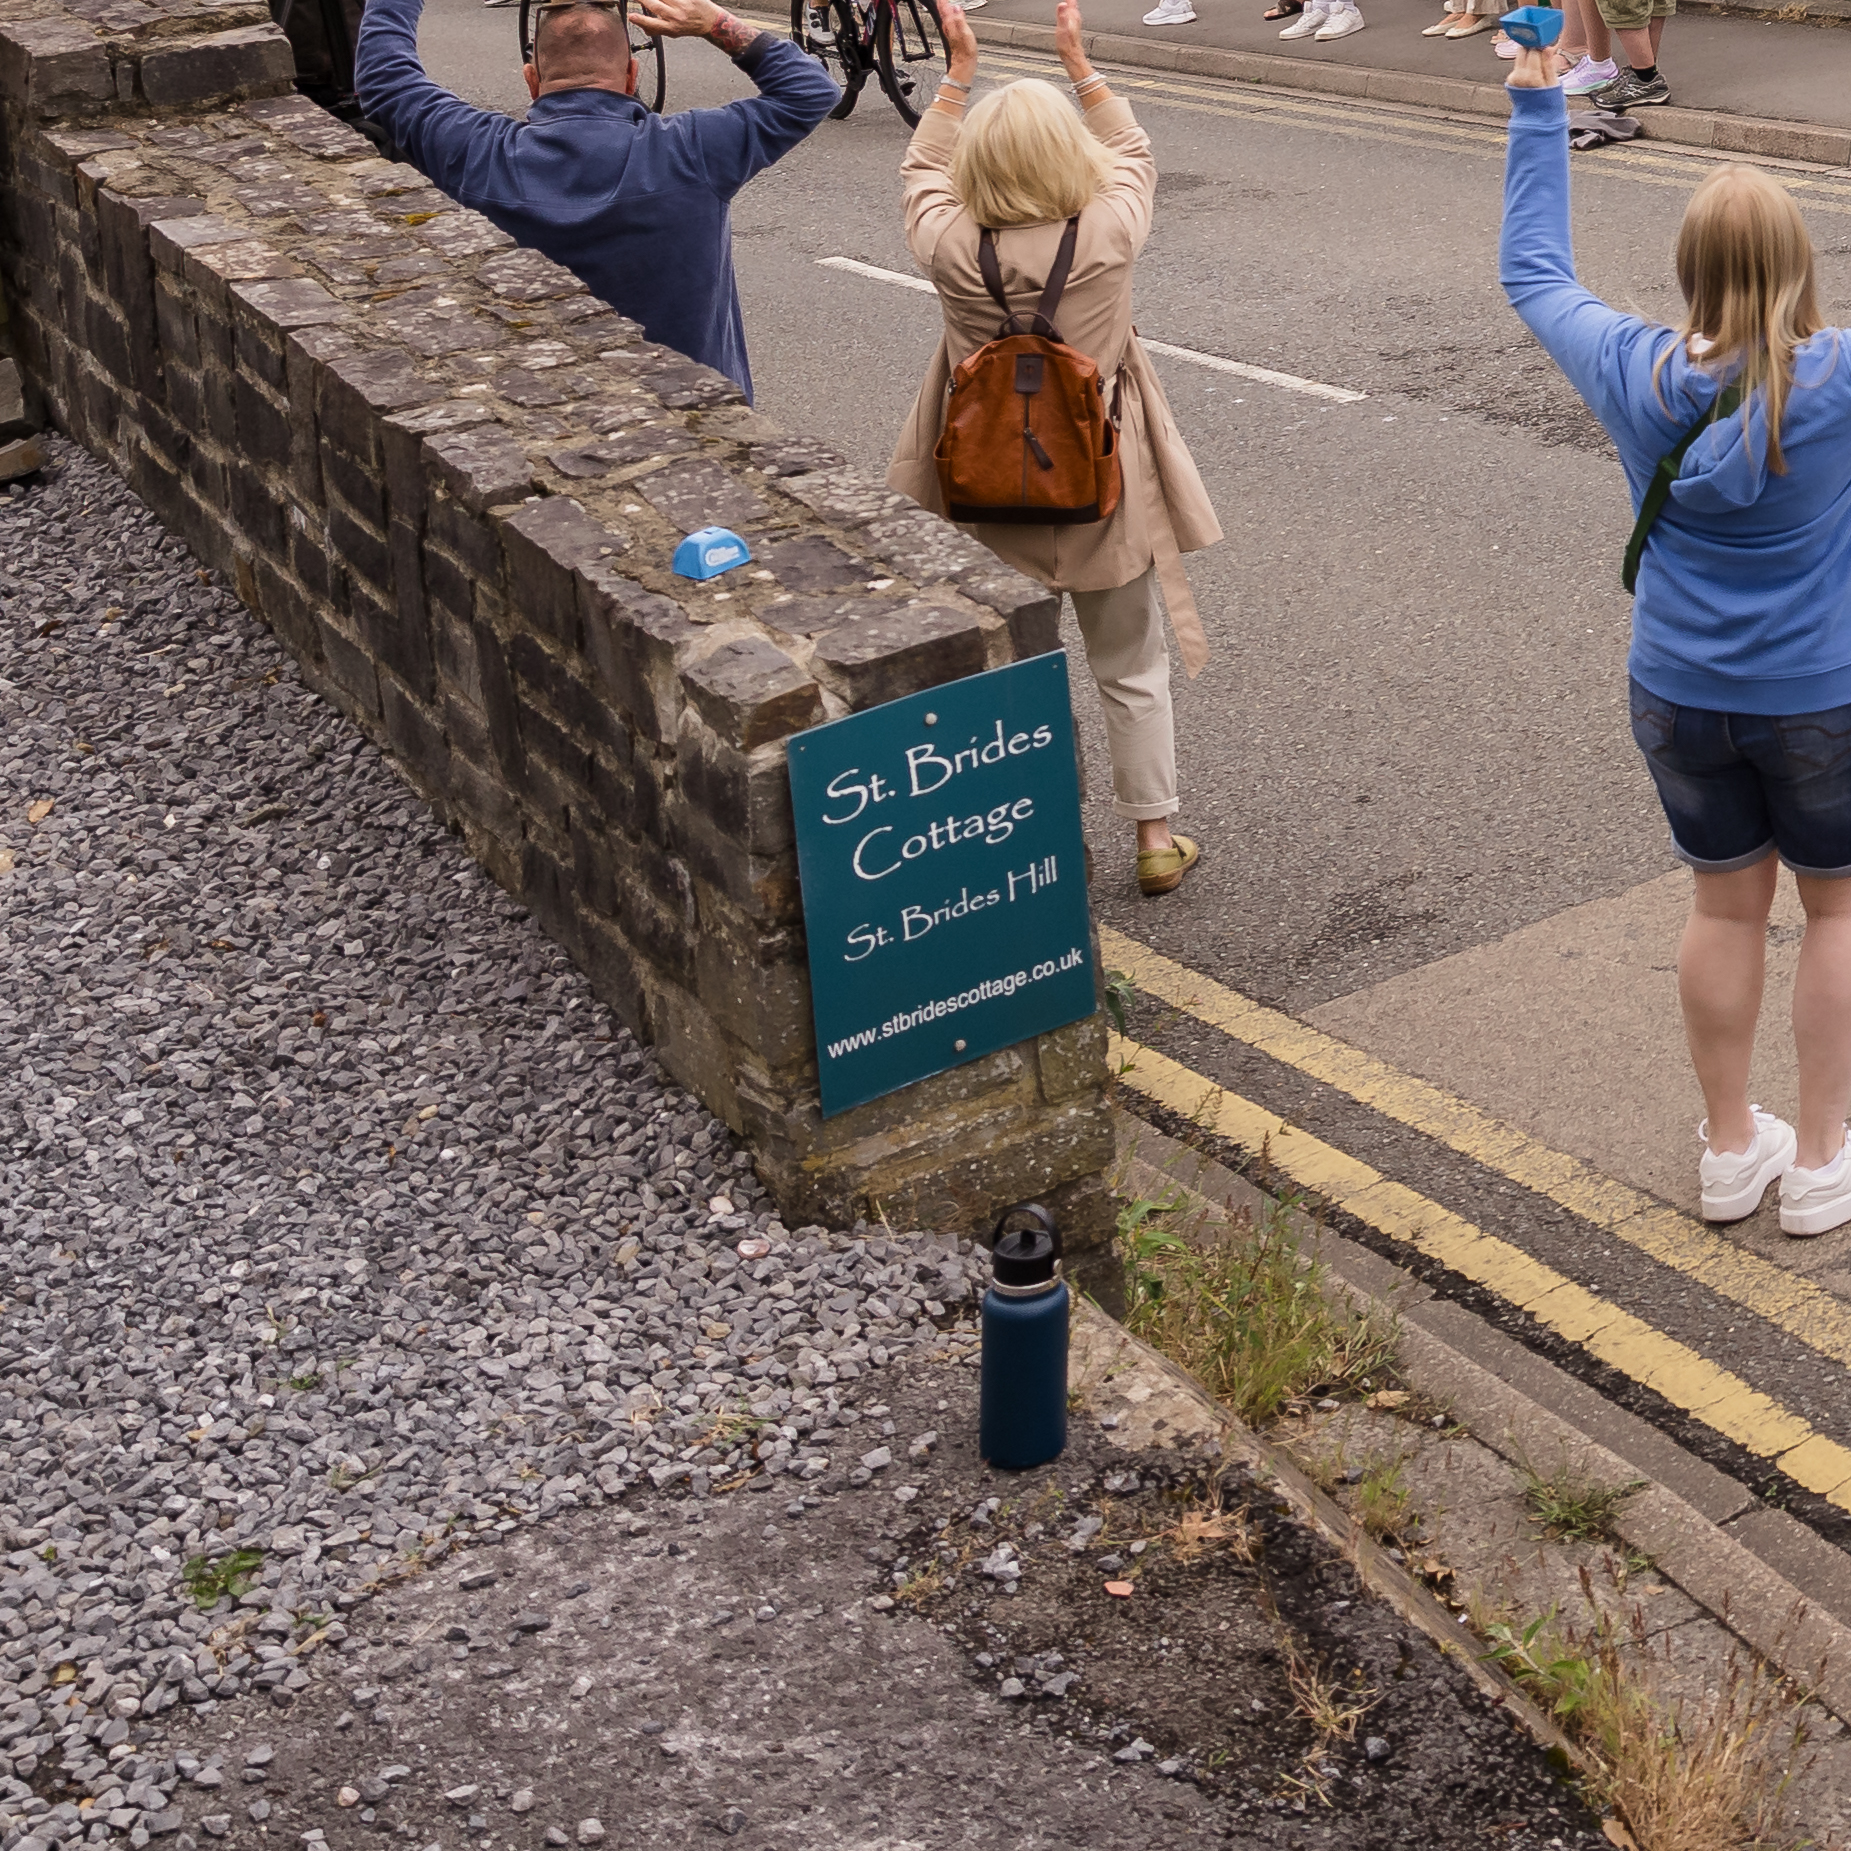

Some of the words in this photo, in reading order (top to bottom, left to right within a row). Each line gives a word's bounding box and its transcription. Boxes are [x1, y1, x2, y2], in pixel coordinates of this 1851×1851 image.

[821, 767, 897, 825] St.
[904, 719, 1053, 797] Brides
[852, 797, 1035, 881] Cottage
[843, 922, 895, 962] St.
[900, 887, 1000, 942] Brides
[1007, 855, 1058, 902] Hill
[827, 947, 1083, 1059] www.stbridescottage.co.uk
